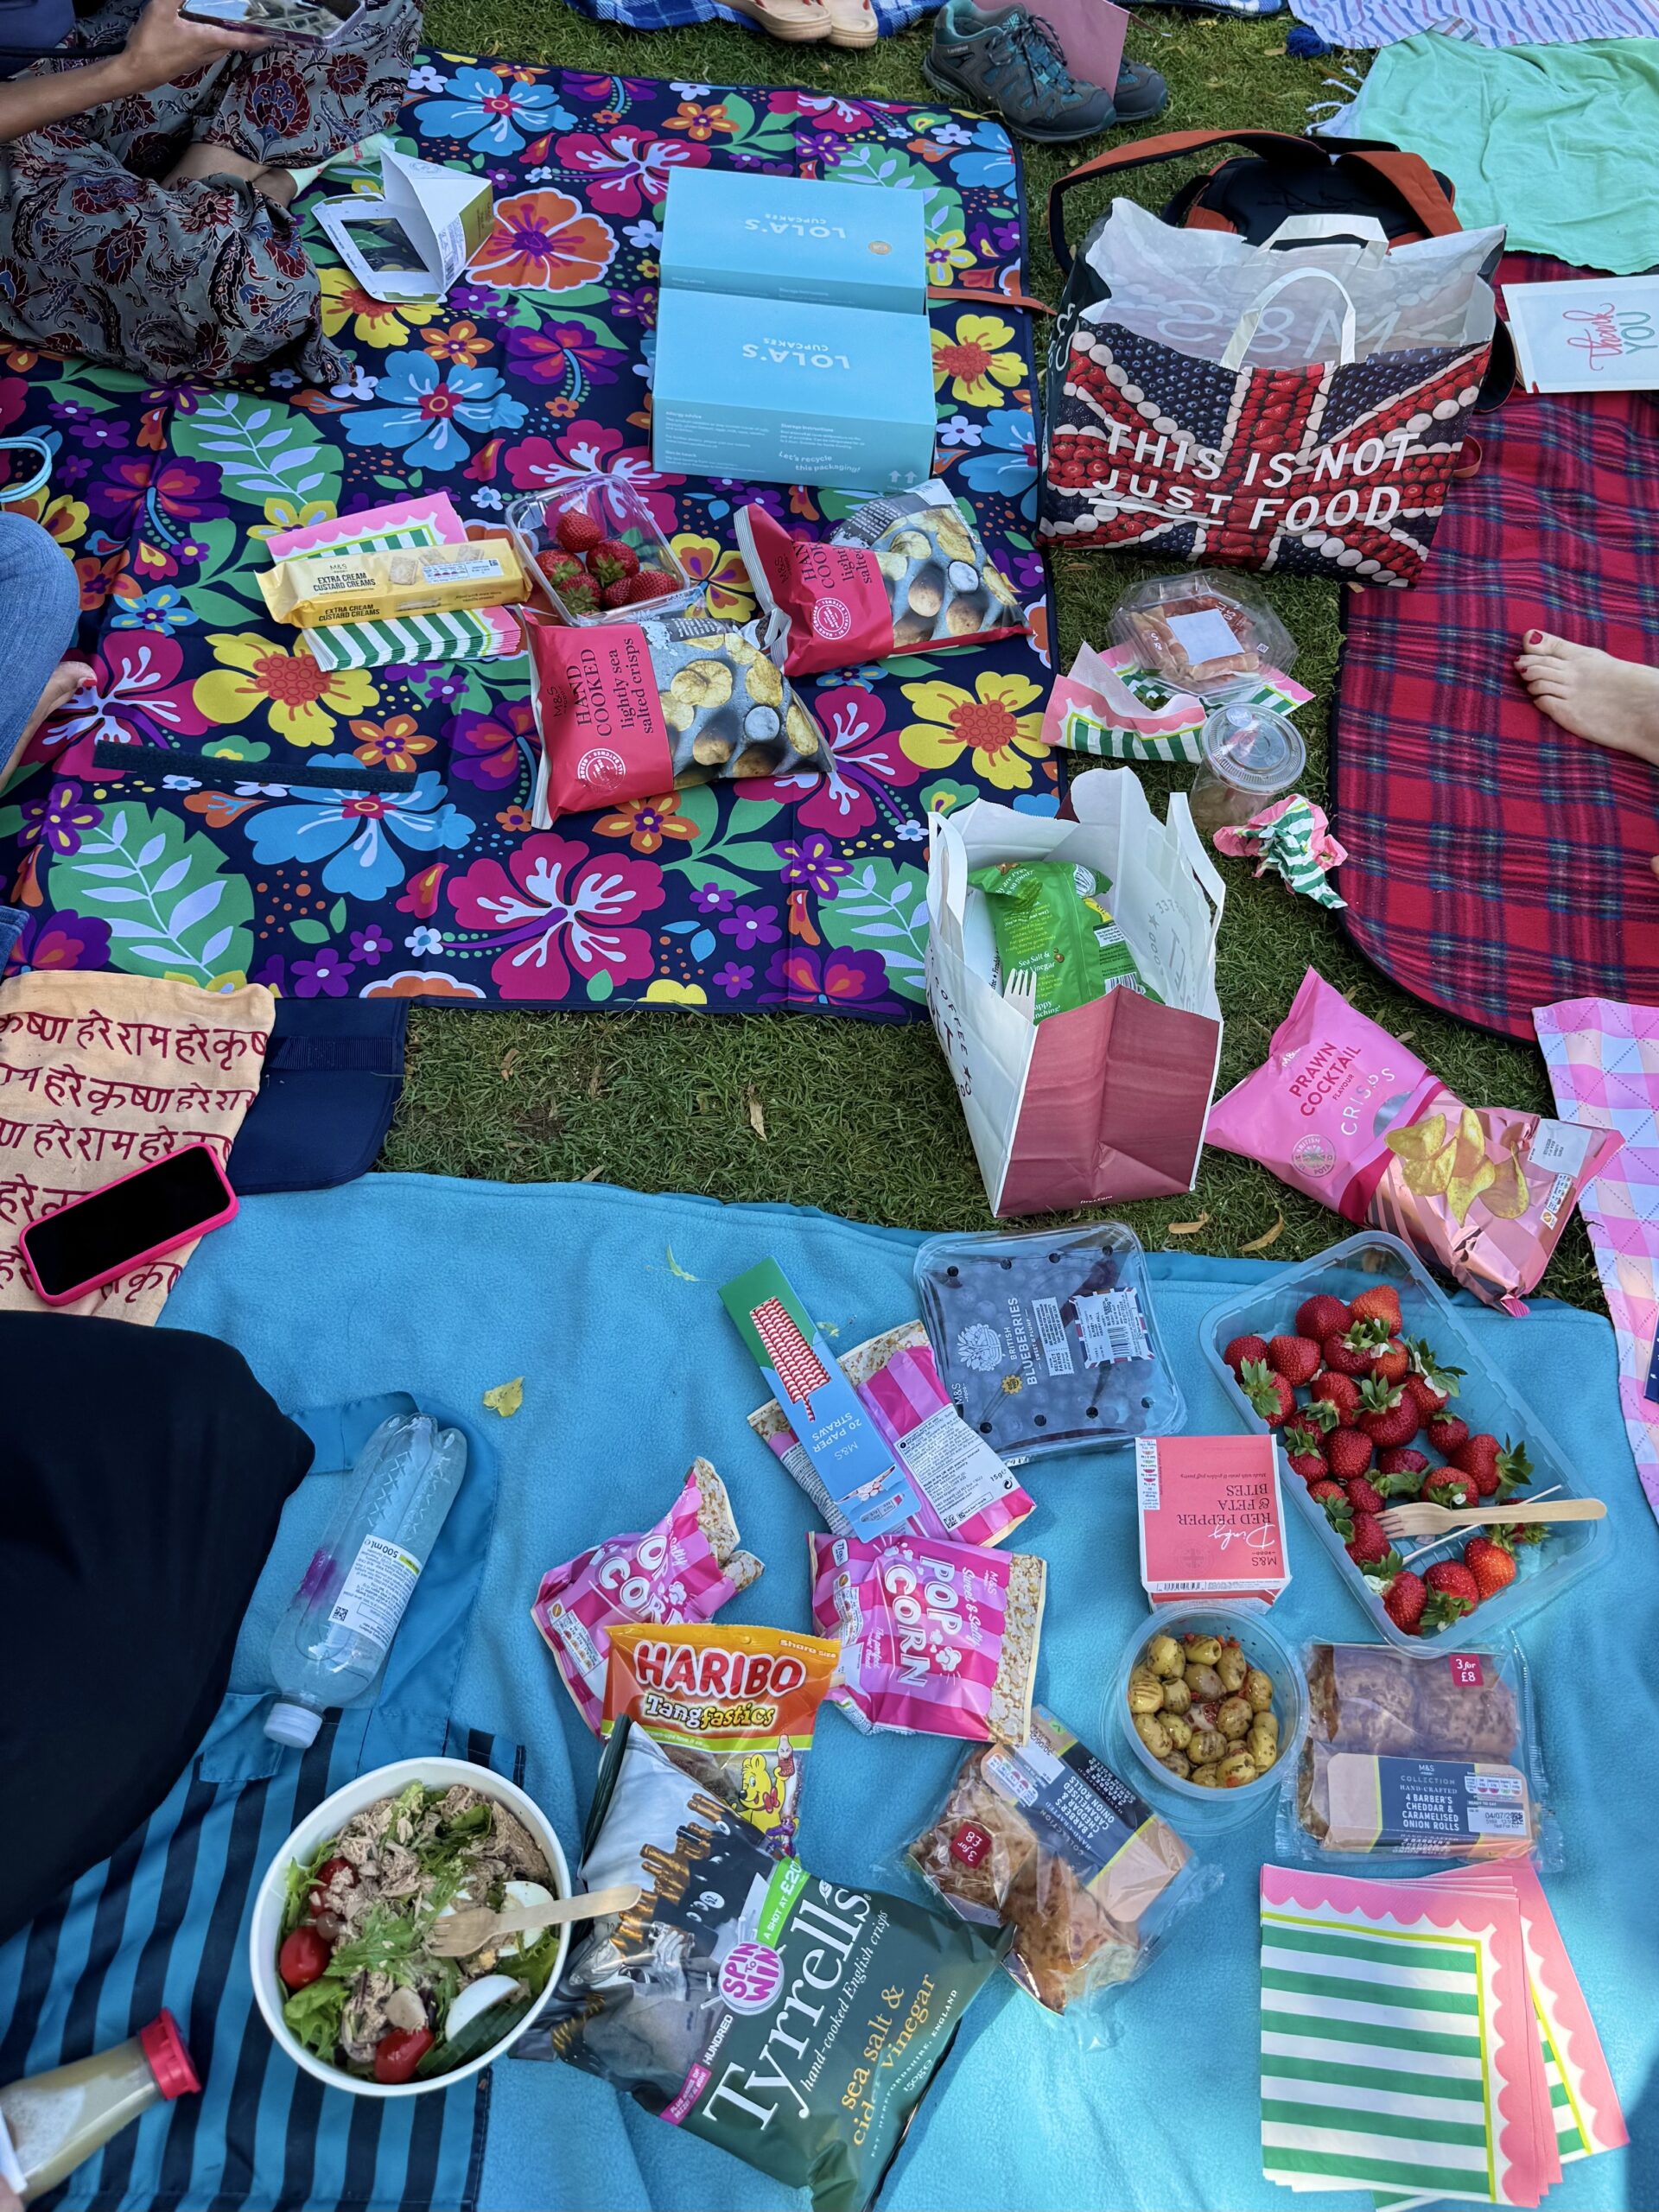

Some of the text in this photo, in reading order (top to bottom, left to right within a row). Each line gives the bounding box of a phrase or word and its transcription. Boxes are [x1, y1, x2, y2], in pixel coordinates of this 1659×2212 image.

[744, 219, 846, 238] LOLA'S
[765, 213, 827, 224] CUPCAKES
[764, 338, 830, 352] CUPCAKES
[1616, 311, 1658, 355] YOU
[742, 344, 849, 369] LOLA'S
[779, 450, 833, 463] Let's recycle
[795, 463, 861, 474] this packaging!
[1105, 415, 1421, 489] THIS IS NOT
[1093, 469, 1401, 531] JUST FOOD
[342, 572, 367, 582] CREAM
[791, 541, 817, 582] HAN
[313, 579, 376, 591] CUSTARD CREAMS
[319, 612, 350, 621] CUSTARD
[325, 606, 347, 614] EXTRA
[548, 686, 563, 717] M&S
[566, 665, 593, 726] HAND
[581, 649, 612, 737] COOKED
[609, 649, 636, 729] lightly sea
[624, 638, 653, 734] salted crisps
[1019, 958, 1030, 967] Sea
[1030, 953, 1043, 963] Salt
[934, 976, 969, 1056] COFFEE
[117, 1020, 173, 1059] राम
[1288, 1042, 1338, 1098] PRAWN
[1300, 1046, 1362, 1116] COCKTAIL
[44, 1063, 214, 1116] हरे कृष्ण हरे
[1332, 1073, 1355, 1101] FLAVOUR
[1341, 1068, 1395, 1136] CRISPS
[34, 1118, 77, 1163] हरे
[76, 1126, 140, 1162] राम
[1004, 1326, 1018, 1360] BRITISH
[1007, 1298, 1039, 1385] BLUEBERRIES
[1027, 1319, 1041, 1362] SWEET PLUMP
[1051, 1353, 1059, 1371] SELECT
[953, 1383, 964, 1406] M&S
[812, 1412, 853, 1441] STRAWS
[812, 1419, 862, 1452] 20 PAPER
[835, 1441, 858, 1460] M&S
[989, 1471, 1002, 1482] 15g
[1226, 1484, 1268, 1497] BITES
[1179, 1513, 1272, 1526] RED PEPPER
[1217, 1498, 1270, 1511] & FETA
[382, 1545, 399, 1559] 500
[1209, 1522, 1276, 1550] Dinky
[1251, 1556, 1277, 1567] M&S
[919, 1555, 963, 1635] POP
[987, 1570, 1000, 1595] M&S
[962, 1567, 984, 1648] Sweet & Salty
[885, 1564, 931, 1687] CORN
[780, 1639, 817, 1654] share
[633, 1640, 806, 1700] HARIBO
[1456, 1658, 1477, 1670] 3 for
[1461, 1672, 1476, 1682] £8
[646, 1693, 776, 1730] Tangfastics
[1401, 1775, 1455, 1785] COLLECTION
[1063, 1782, 1109, 1830] CARAMELISED
[1069, 1776, 1115, 1823] ONION ROLLS
[1406, 1802, 1444, 1812] CHEDDAR
[1413, 1794, 1453, 1804] BARBER'S
[1040, 1809, 1084, 1856] COLLECTION
[1055, 1798, 1089, 1834] BARBER'S
[1068, 1799, 1100, 1834] CHEDDAR
[1402, 1811, 1459, 1822] CARAMELISED
[1403, 1820, 1460, 1832] ONION ROLLS
[957, 1836, 978, 1863] 3 for
[966, 1831, 983, 1847] £8
[763, 1897, 789, 1940] A SHOT AT
[722, 1943, 760, 1998] SPIN
[745, 1947, 779, 2002] WIN
[702, 1885, 869, 2131] Tyrrells
[799, 1909, 889, 2093] hand-cooked English crisps
[931, 1988, 958, 2038] ENGLAND
[880, 1974, 936, 2069] vinegar
[702, 2014, 734, 2066] HUNDRED
[841, 1985, 905, 2110] sea salt &
[671, 2098, 684, 2113] PLUS
